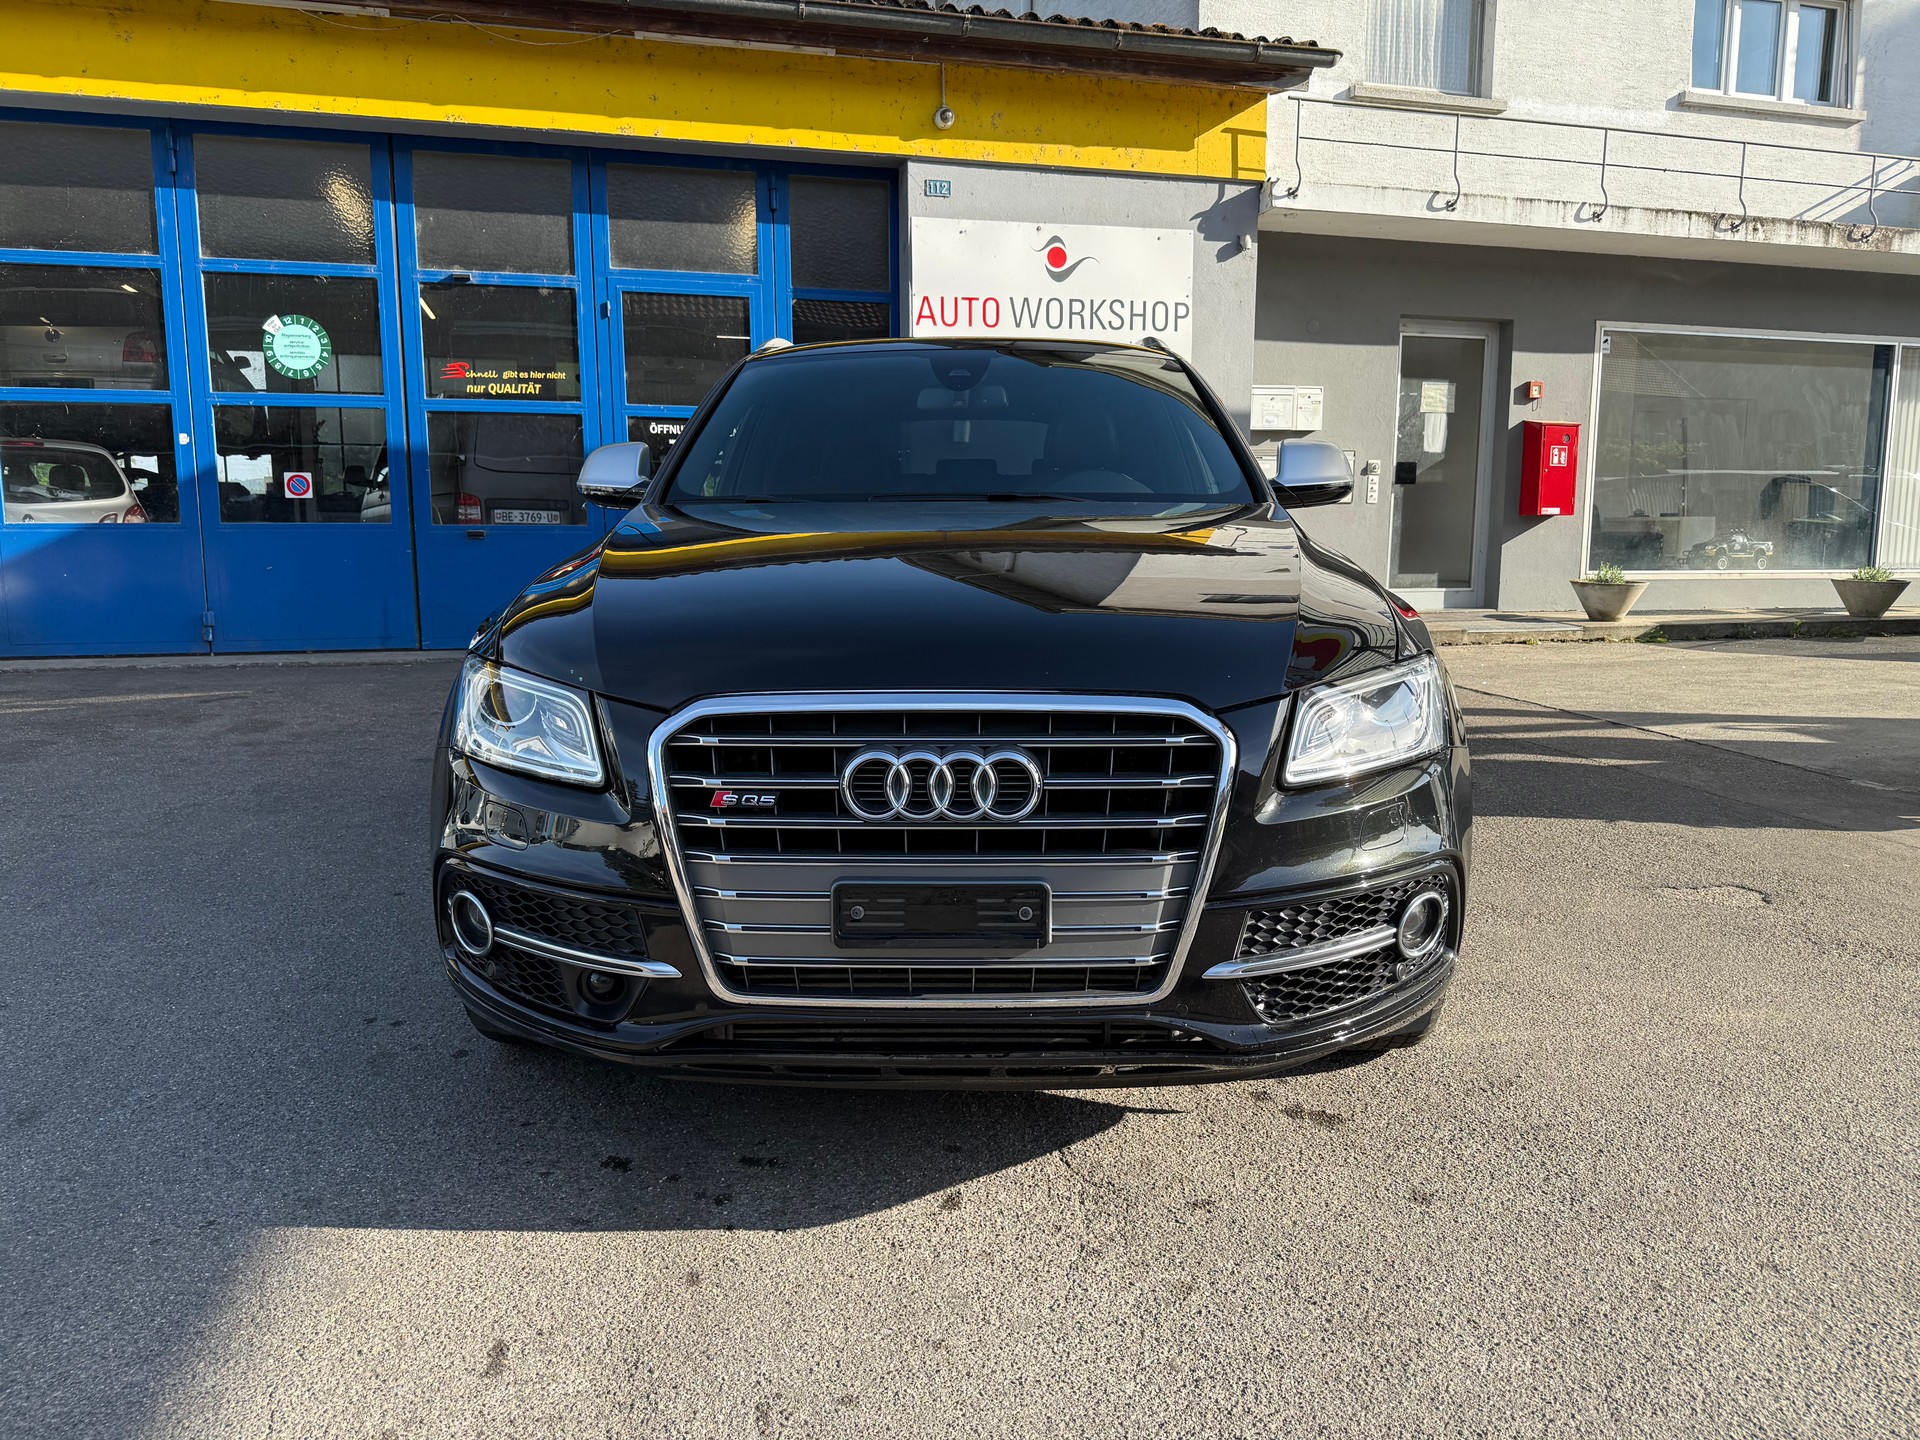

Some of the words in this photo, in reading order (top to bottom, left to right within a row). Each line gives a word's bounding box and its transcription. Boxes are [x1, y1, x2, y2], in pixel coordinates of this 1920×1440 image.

[929, 181, 948, 194] 112
[915, 296, 1000, 328] AUTO
[1009, 296, 1190, 332] WORKSHOP
[265, 334, 273, 343] 10
[440, 362, 498, 379] Schnell
[502, 370, 518, 379] gibt
[530, 371, 545, 379] hier
[546, 371, 566, 380] nicht
[466, 384, 486, 393] nur
[488, 382, 541, 395] QUALITÄT
[720, 794, 776, 806] SQ5
